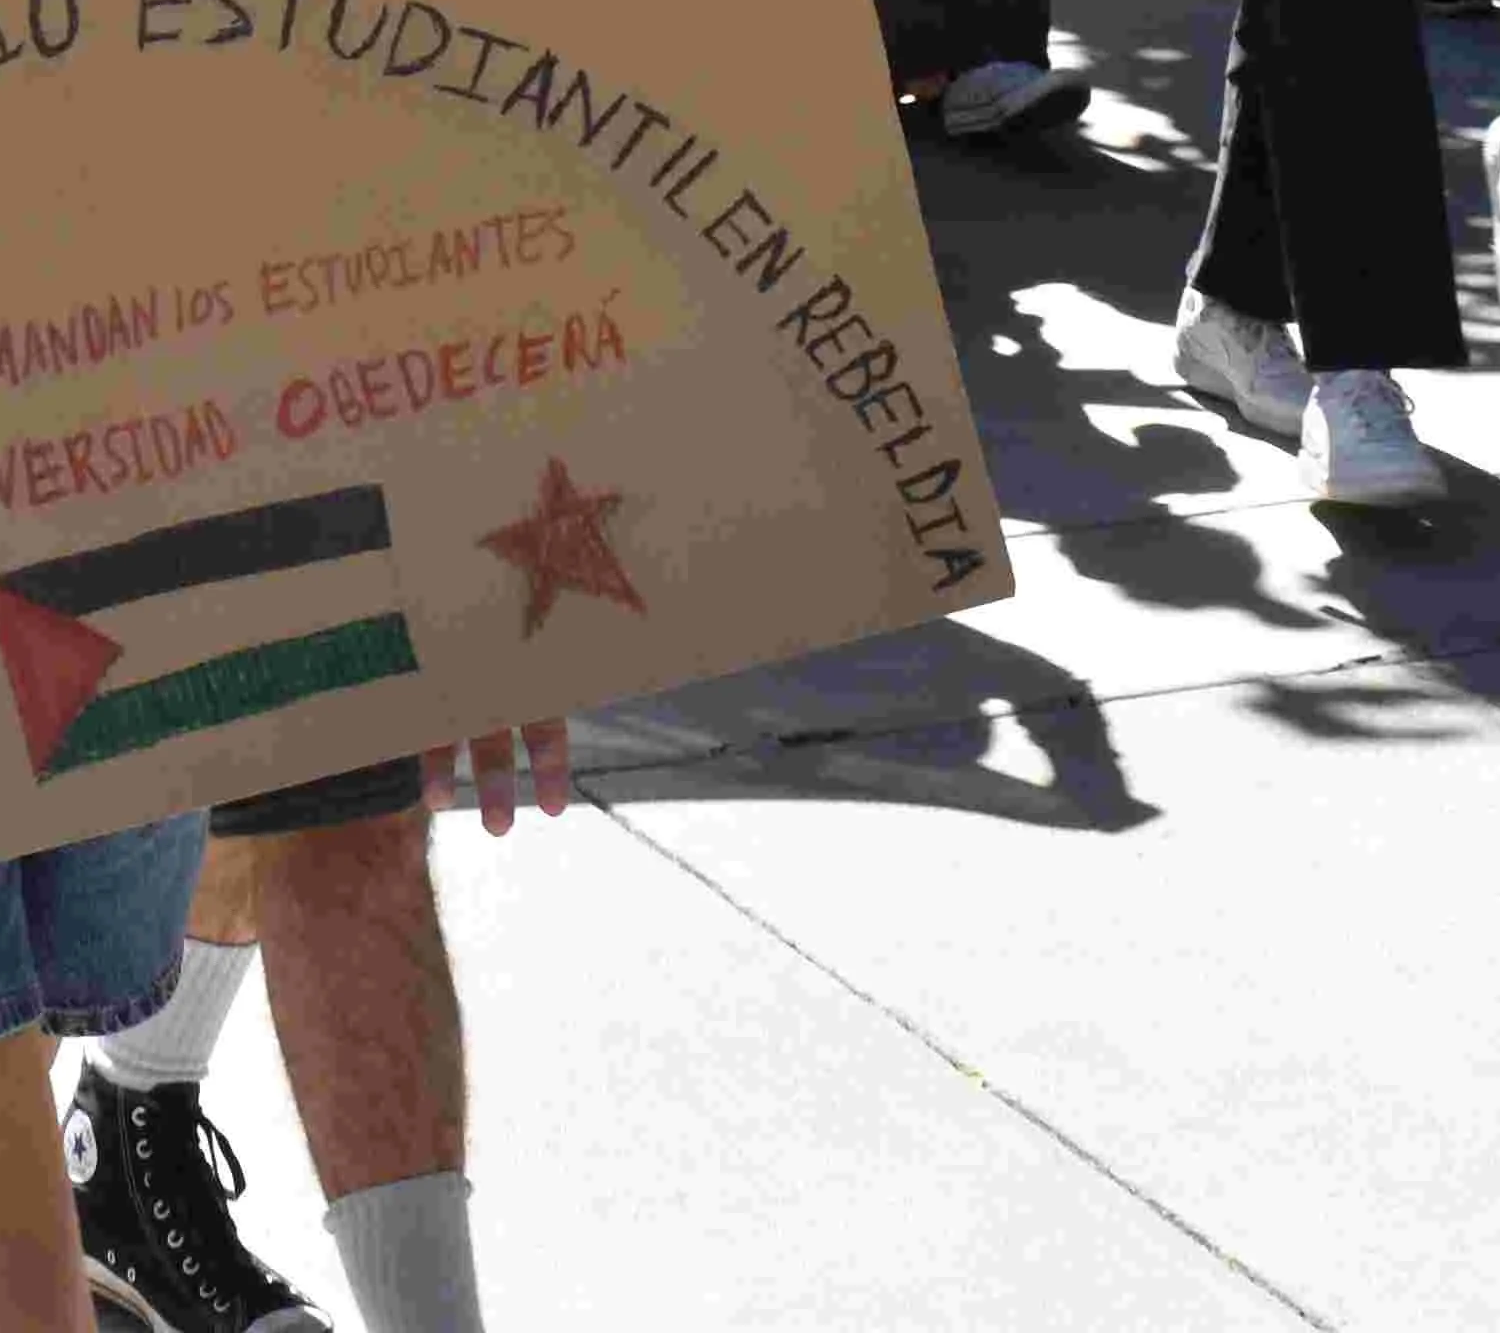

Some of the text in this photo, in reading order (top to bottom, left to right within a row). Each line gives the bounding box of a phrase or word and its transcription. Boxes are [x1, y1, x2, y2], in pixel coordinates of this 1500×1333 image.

[259, 207, 576, 317] ESTUDIANTES
[276, 288, 628, 440] OBEDECERÁ
[702, 188, 805, 294] EN
[776, 274, 984, 593] REBELDIA
